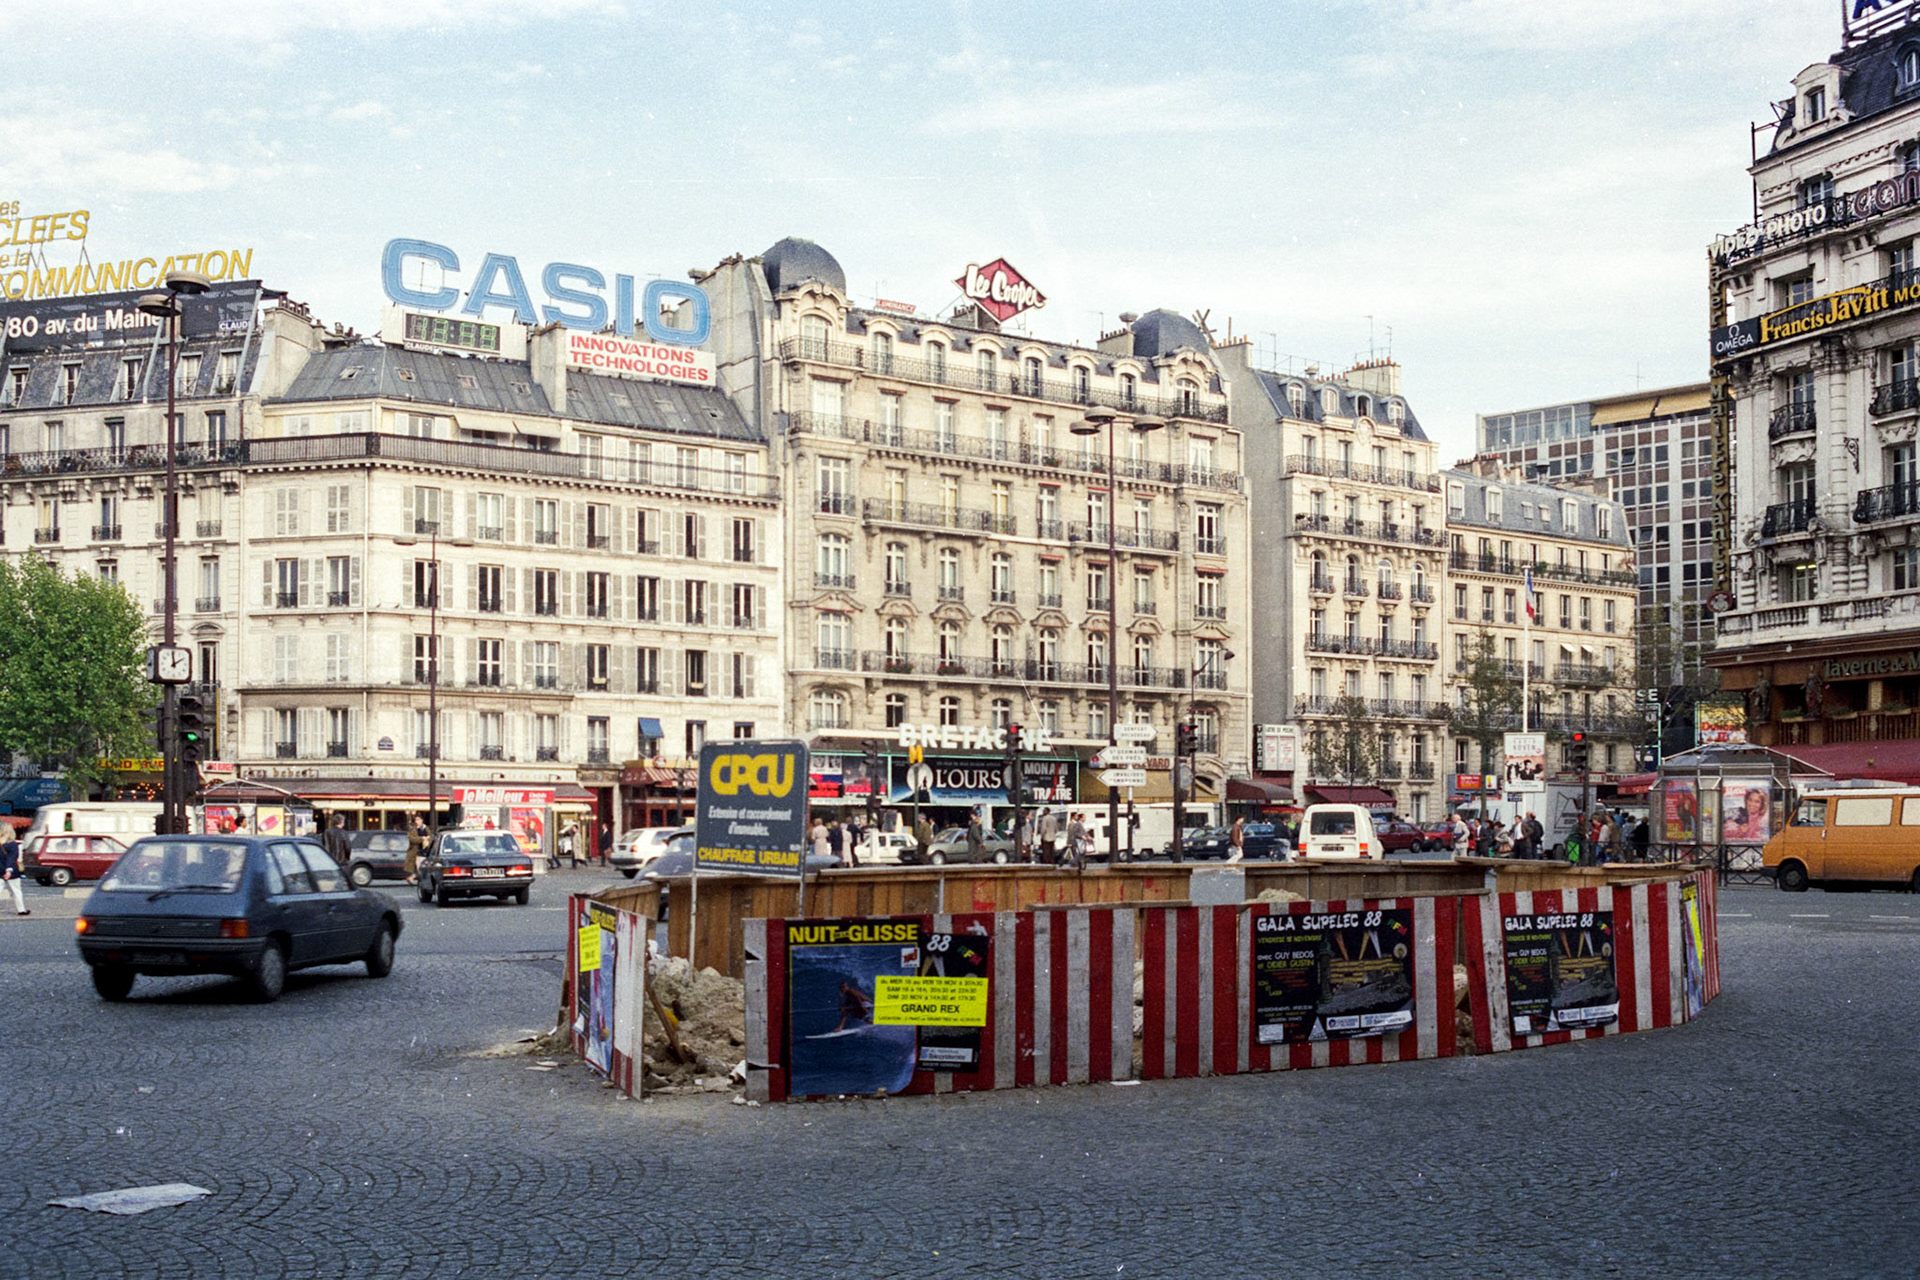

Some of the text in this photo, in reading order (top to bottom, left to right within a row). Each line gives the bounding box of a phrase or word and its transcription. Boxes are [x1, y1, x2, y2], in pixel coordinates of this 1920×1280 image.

[0, 248, 253, 300] OMMUNICATION
[381, 237, 712, 348] CASIO
[965, 264, 1045, 312] Lee Cooper
[7, 315, 39, 338] 80
[73, 312, 98, 333] du
[219, 319, 252, 331] CLAUD
[1760, 286, 1889, 344] Francis Javitt
[571, 335, 695, 364] INNOVATIONS
[1715, 334, 1754, 352] OMEGA
[570, 350, 709, 381] TECHNOLOGIES
[1823, 658, 1889, 678] Taverne
[1892, 656, 1905, 672] de
[710, 753, 795, 797] CPCU
[936, 763, 1002, 789] L'OURS
[698, 846, 755, 863] CHAUFFAGE
[758, 850, 799, 866] URBAIN
[1257, 910, 1383, 932] GALA SUPELEC 88
[1504, 912, 1594, 931] GALA SUPELEC 88
[789, 925, 840, 943] NUIT
[848, 924, 919, 942] GLISSE
[926, 934, 951, 952] 88
[1274, 951, 1290, 960] GUY
[1292, 950, 1315, 960] BEDOS
[901, 1003, 961, 1014] GRAND REX
